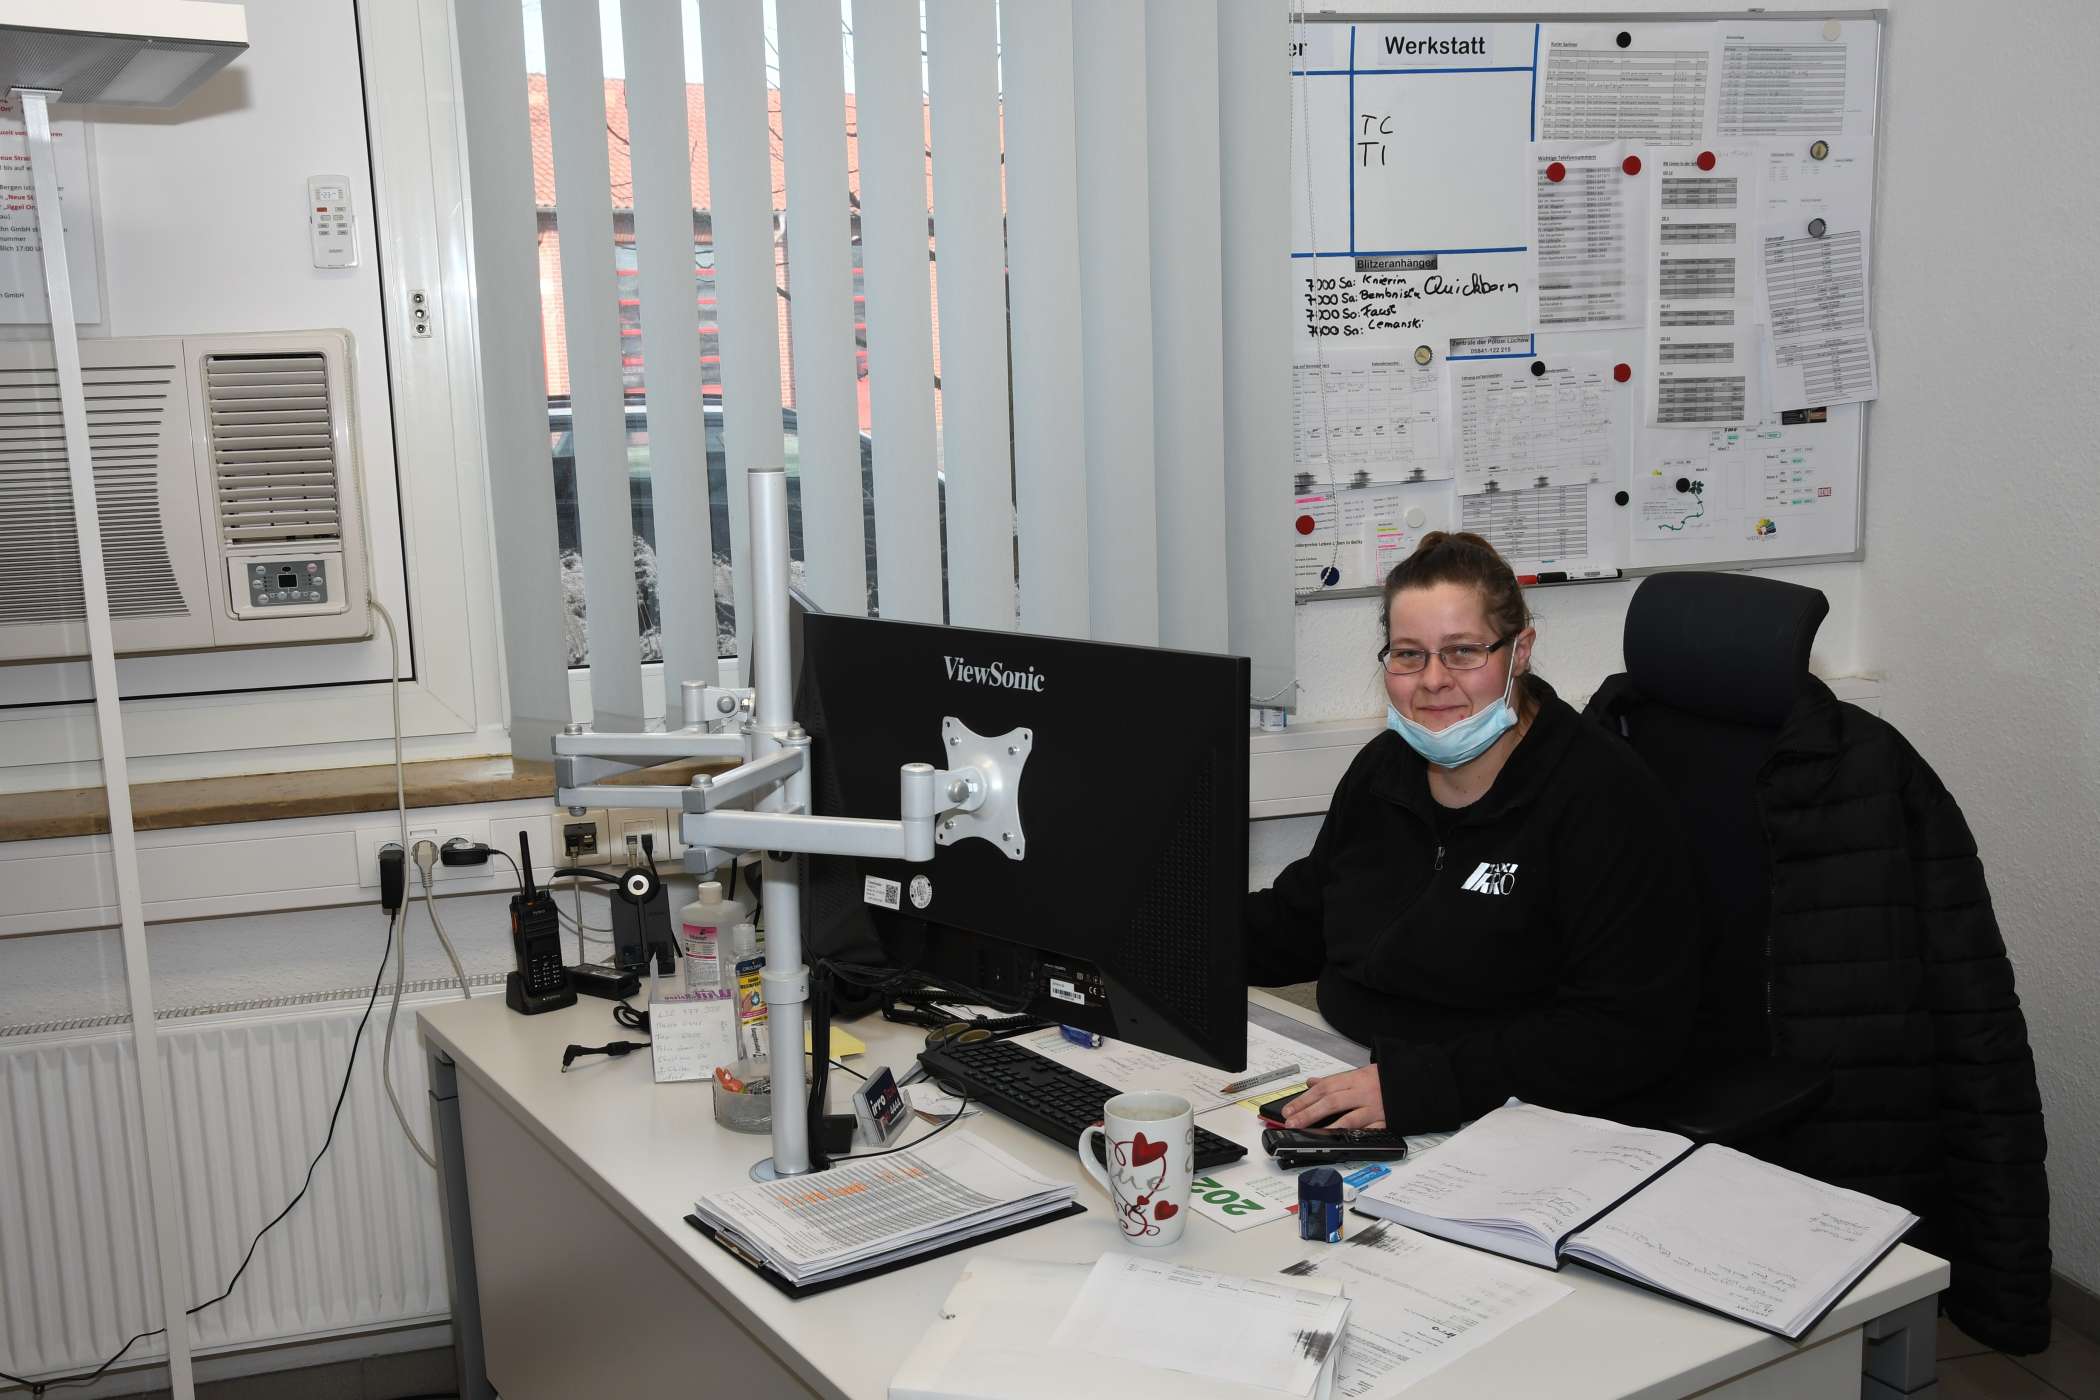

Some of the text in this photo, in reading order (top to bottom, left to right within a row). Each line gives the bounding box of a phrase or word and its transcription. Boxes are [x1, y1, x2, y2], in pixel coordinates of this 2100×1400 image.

[1385, 36, 1486, 55] Werkstatt
[1357, 258, 1437, 270] Blitzeranhänger
[944, 656, 1045, 692] ViewSonic
